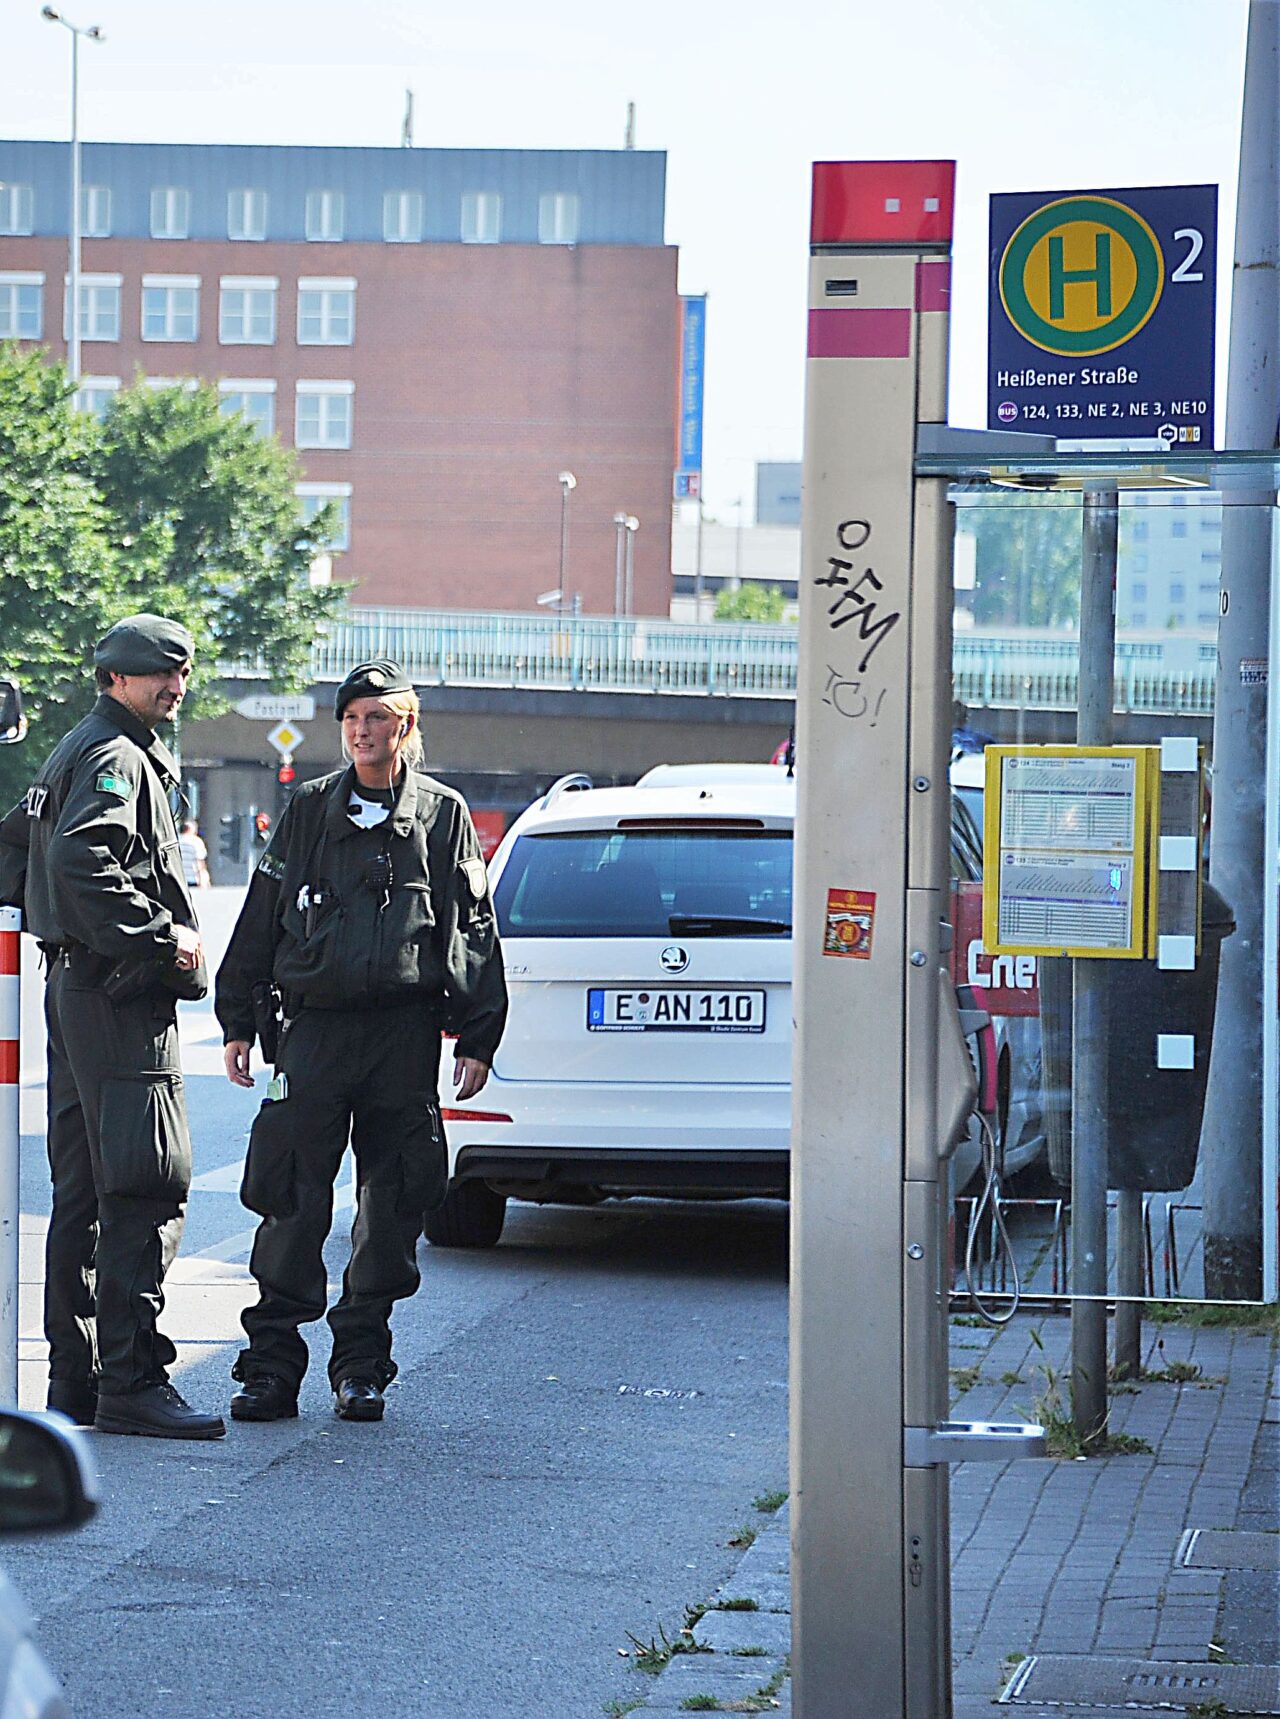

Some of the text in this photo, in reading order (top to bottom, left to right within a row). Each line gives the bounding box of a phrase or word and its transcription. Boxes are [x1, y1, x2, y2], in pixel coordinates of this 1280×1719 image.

[1172, 228, 1203, 282] 2
[1049, 233, 1111, 319] H
[997, 367, 1138, 387] Heißener Straße
[999, 401, 1207, 420] BUS 124, 133, NE 2, NE 3, NE10
[616, 994, 634, 1021] E
[654, 994, 691, 1022] AN
[699, 994, 753, 1022] 110
